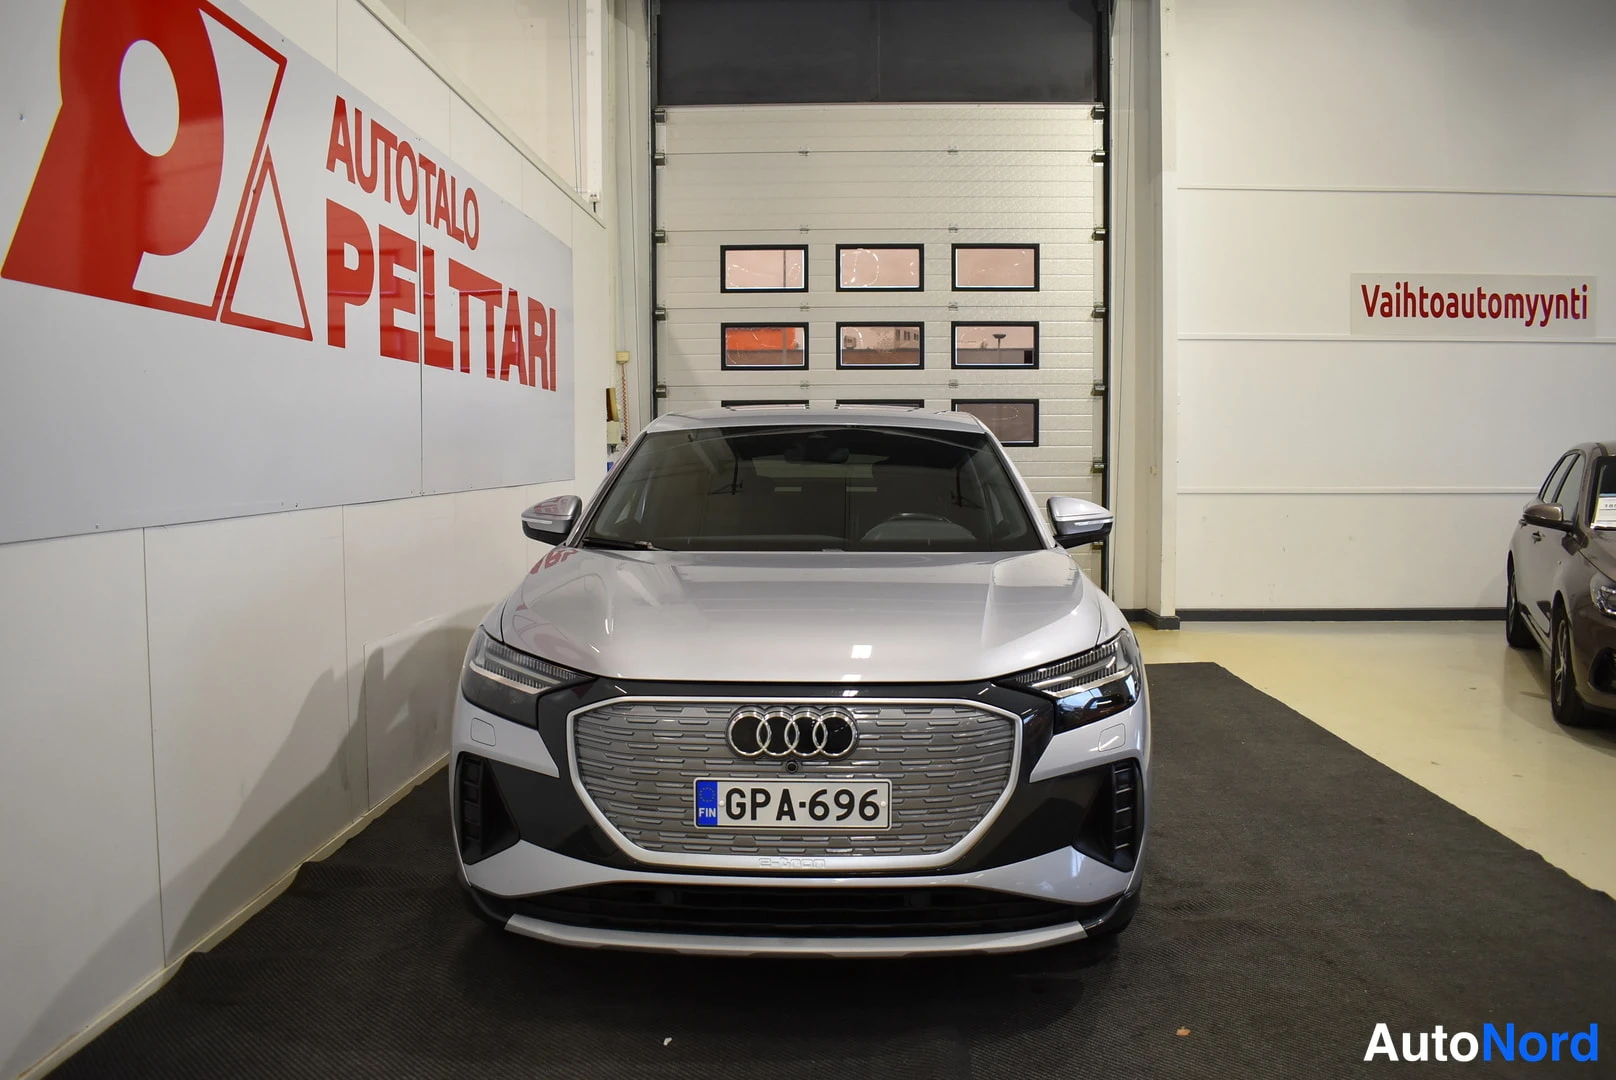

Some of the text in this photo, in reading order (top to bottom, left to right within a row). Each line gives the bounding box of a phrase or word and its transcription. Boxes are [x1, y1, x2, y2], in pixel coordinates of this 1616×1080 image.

[326, 95, 480, 250] AUTOTALO
[326, 198, 557, 392] PELTTARI
[1361, 281, 1589, 327] Vaihtoautomyynti
[698, 807, 717, 818] FIN
[725, 787, 880, 821] GPA-696
